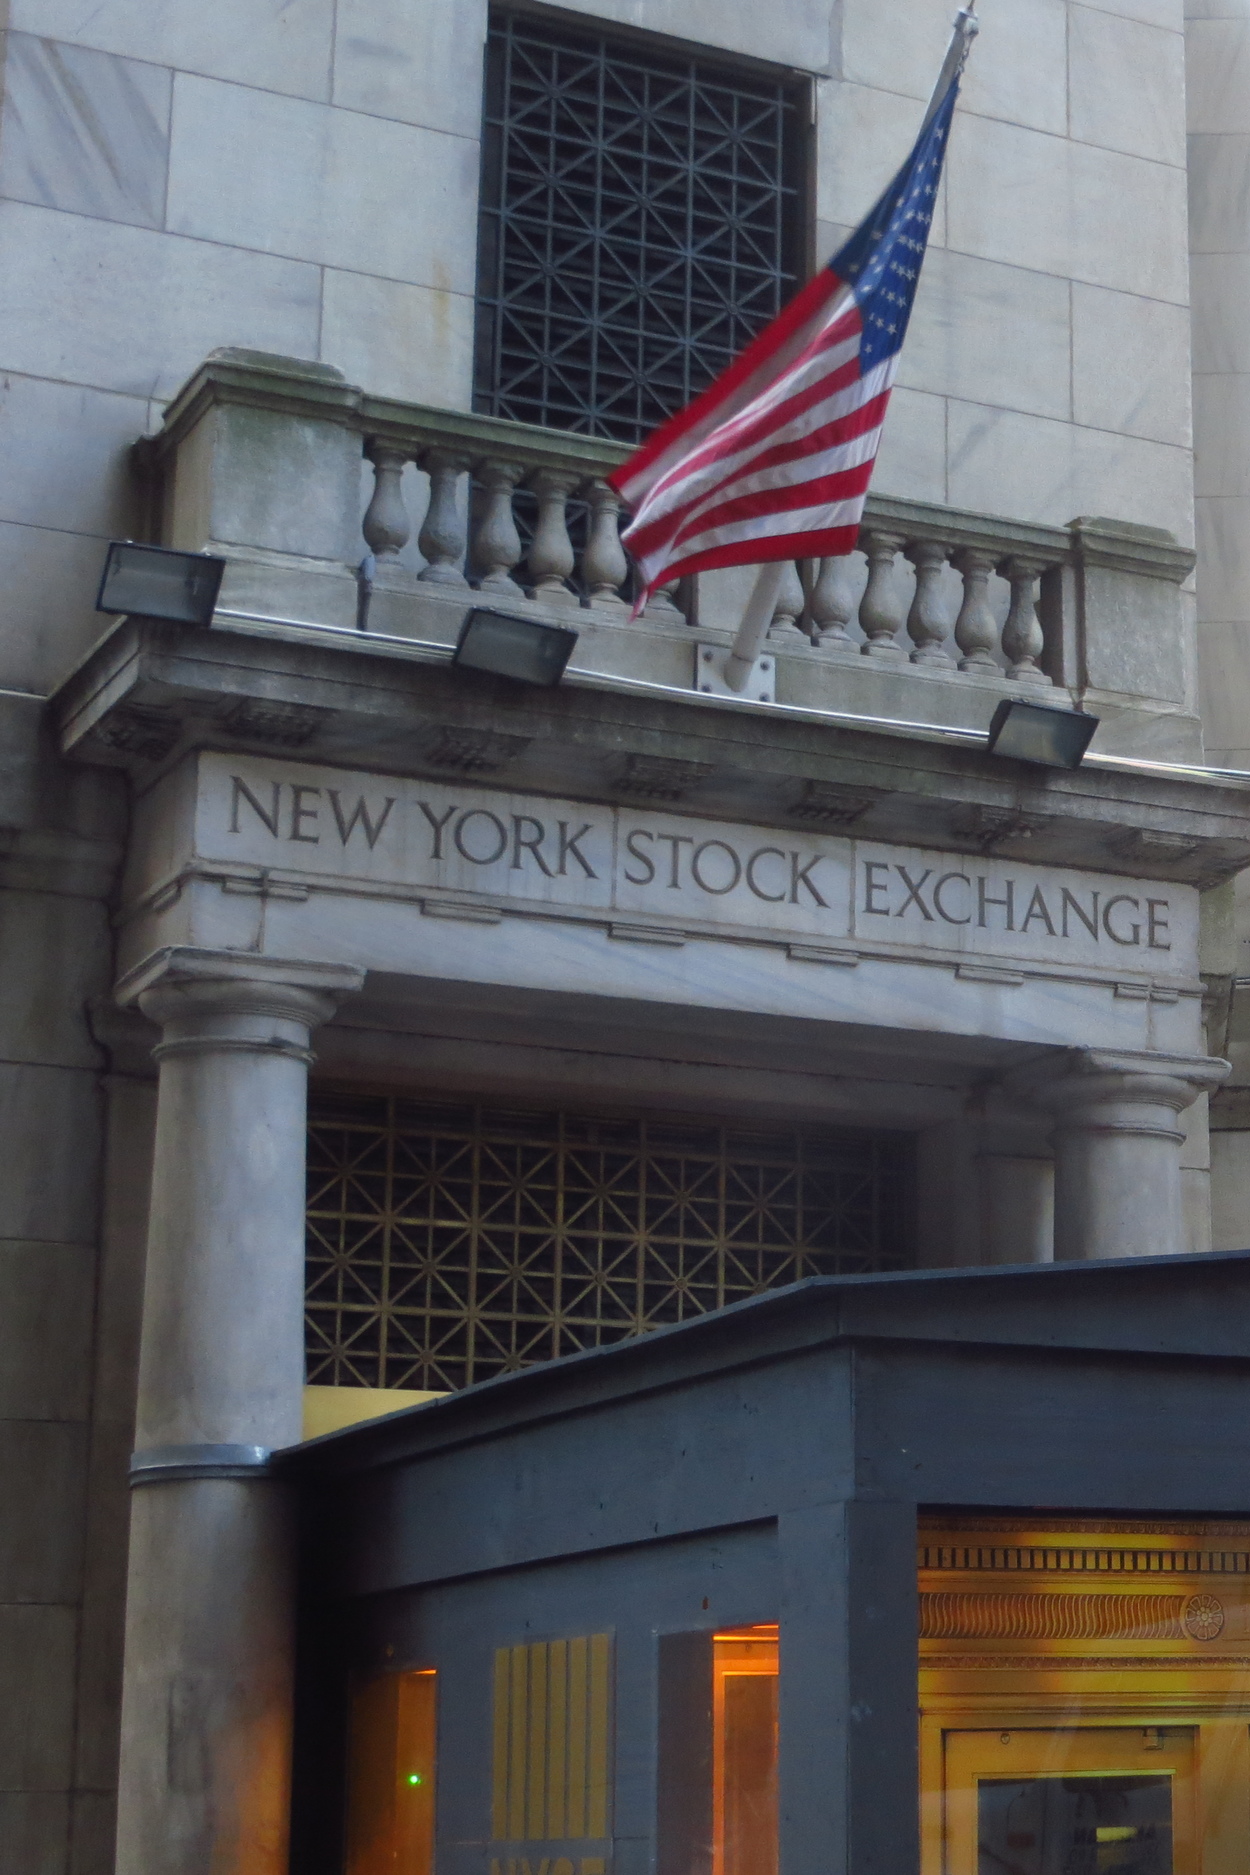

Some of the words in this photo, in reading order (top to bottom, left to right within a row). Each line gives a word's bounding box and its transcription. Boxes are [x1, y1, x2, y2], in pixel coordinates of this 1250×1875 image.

[228, 776, 396, 850] NEW
[417, 801, 599, 879] YORK
[624, 829, 831, 908] STOCK
[862, 861, 1172, 951] EXCHANGE
